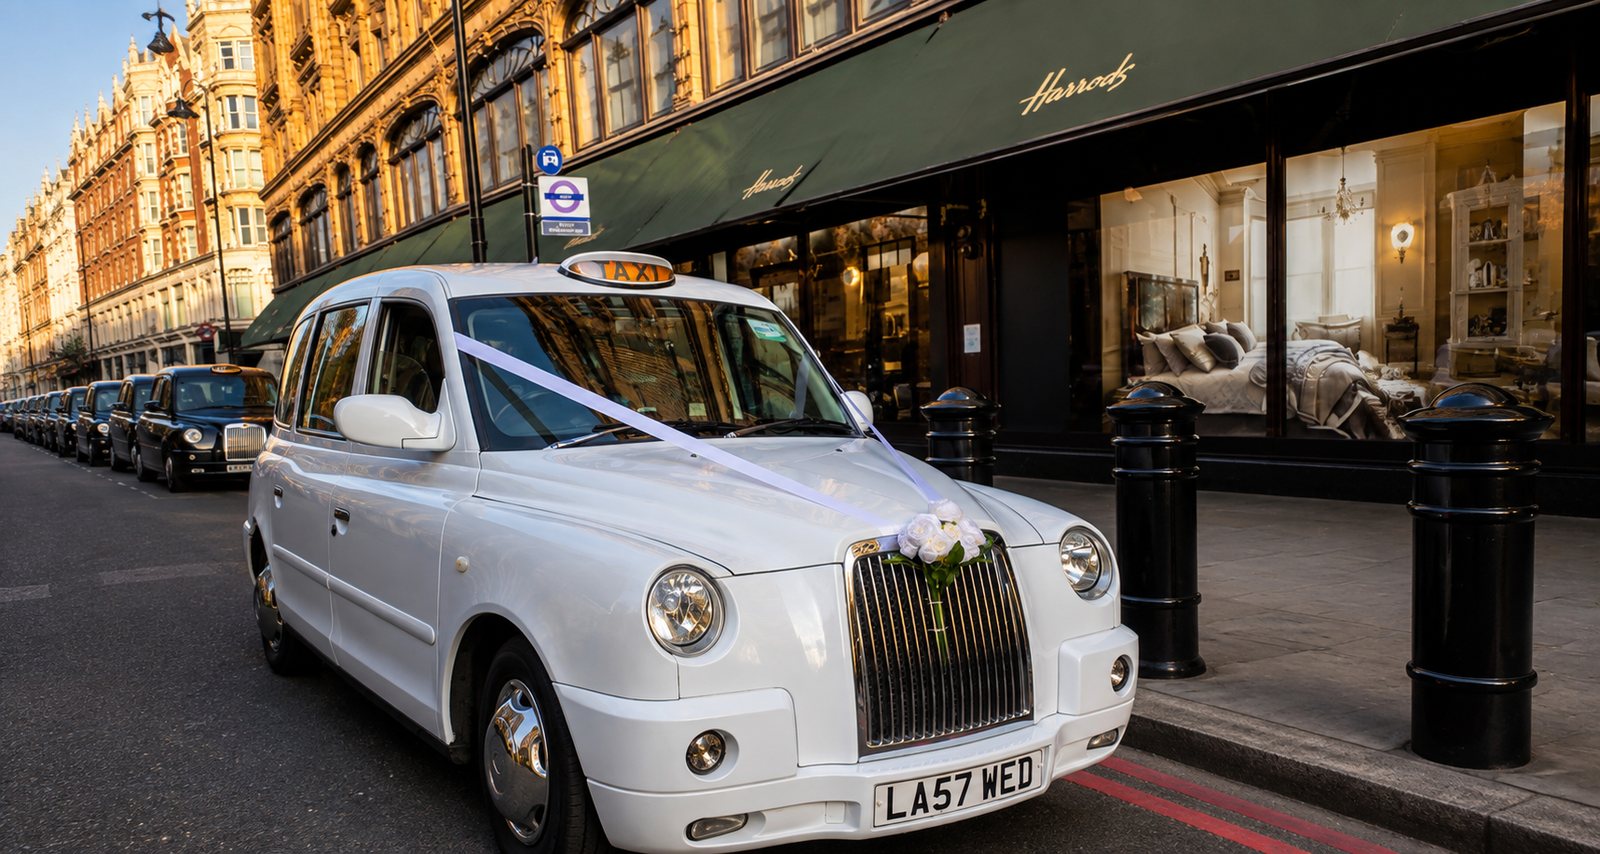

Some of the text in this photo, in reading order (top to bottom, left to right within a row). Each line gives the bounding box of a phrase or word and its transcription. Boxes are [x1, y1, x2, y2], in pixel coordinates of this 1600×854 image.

[1019, 52, 1136, 116] Harrods
[592, 260, 659, 282] TAXI
[886, 756, 1033, 821] LA57 WED
